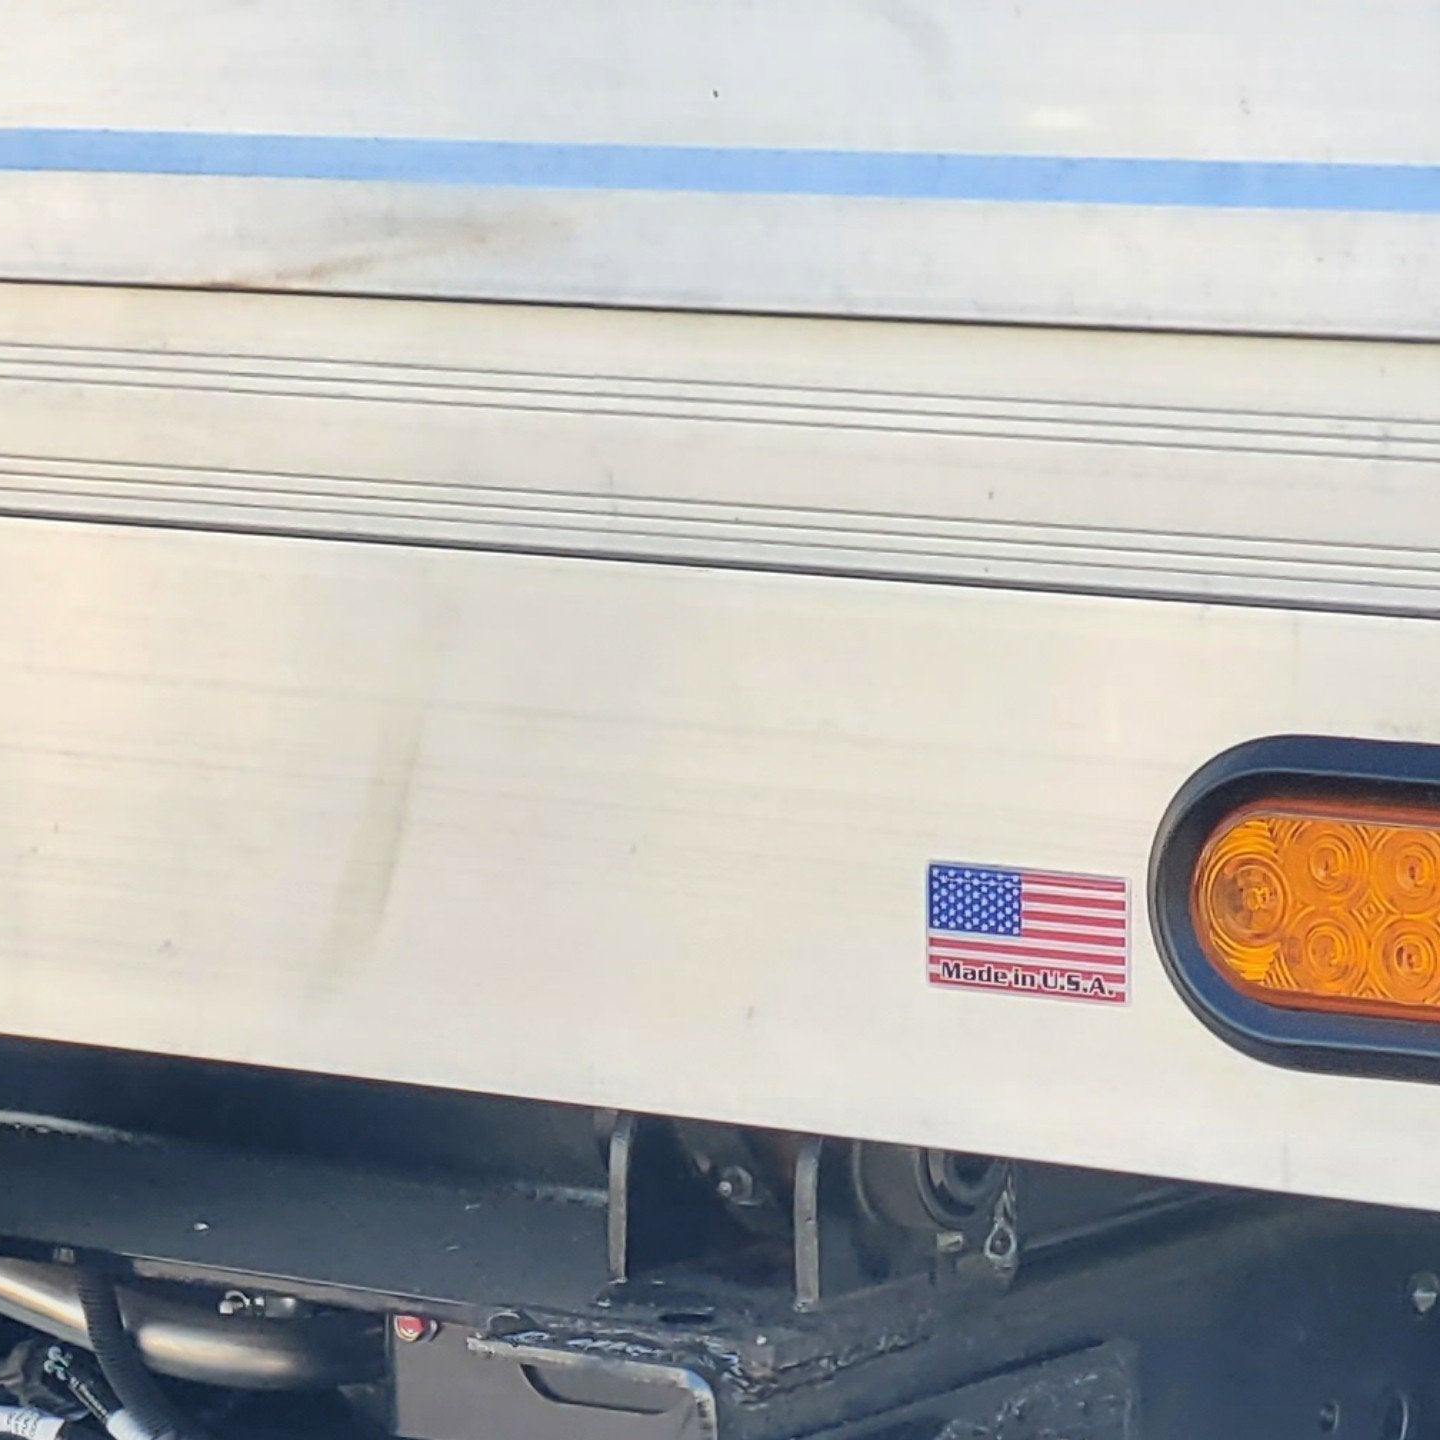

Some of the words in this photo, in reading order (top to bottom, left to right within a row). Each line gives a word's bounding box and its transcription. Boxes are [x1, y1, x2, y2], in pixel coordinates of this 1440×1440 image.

[941, 960, 1008, 985] Made
[1013, 968, 1036, 988] in
[1042, 972, 1115, 996] U.S.A.
